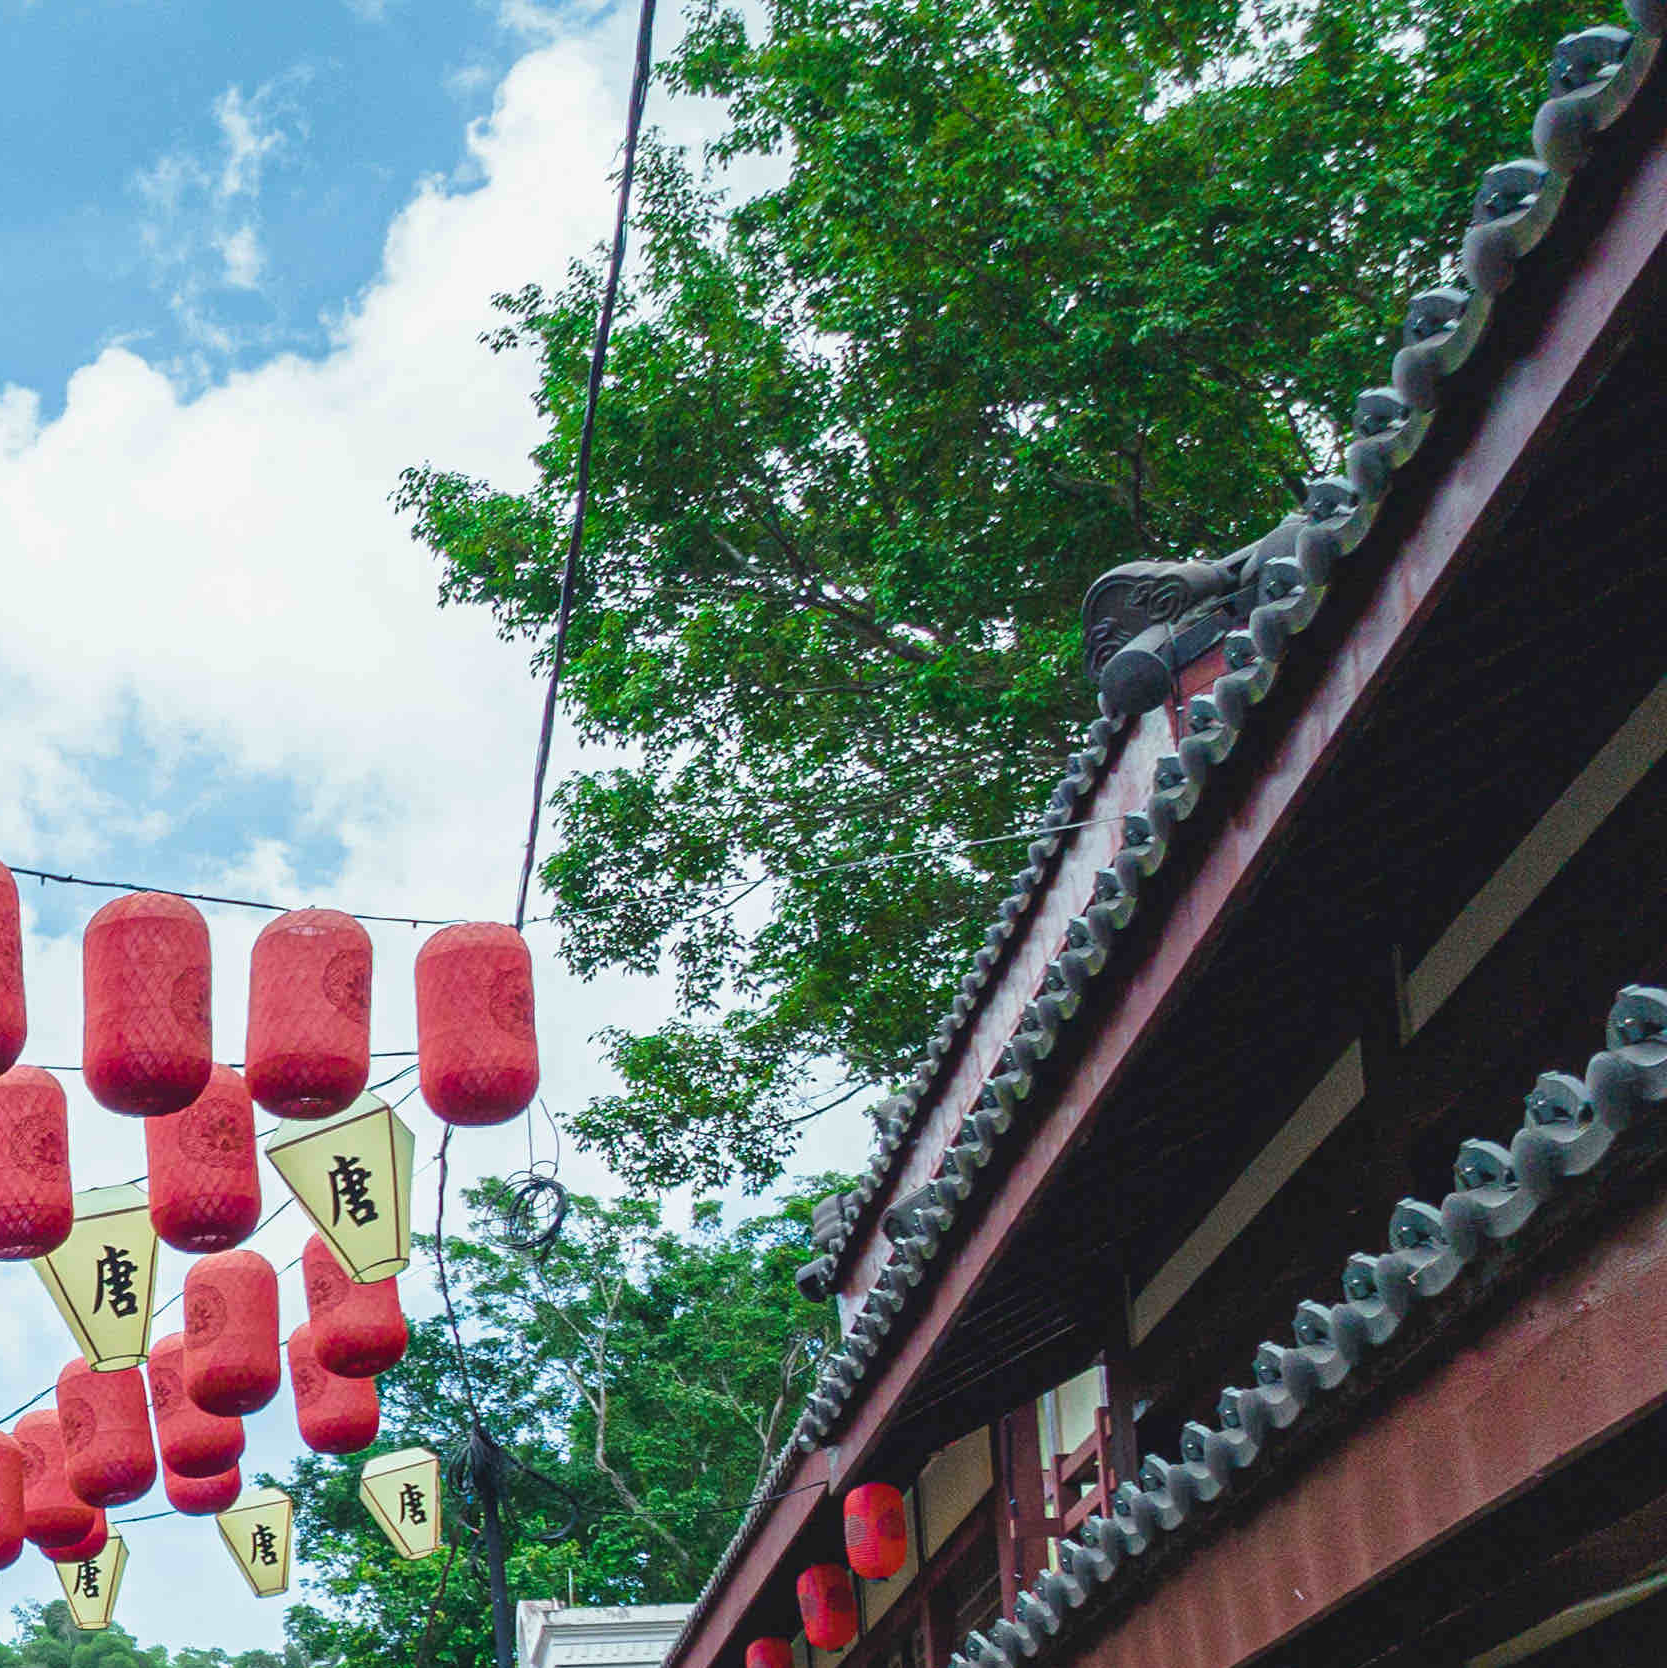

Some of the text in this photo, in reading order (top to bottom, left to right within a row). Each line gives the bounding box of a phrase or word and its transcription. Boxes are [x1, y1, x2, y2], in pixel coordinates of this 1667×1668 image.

[328, 1156, 378, 1226] 唐
[92, 1245, 138, 1318] 唐
[400, 1483, 428, 1525] 唐
[251, 1523, 278, 1566] 唐
[73, 1559, 101, 1599] 唐
